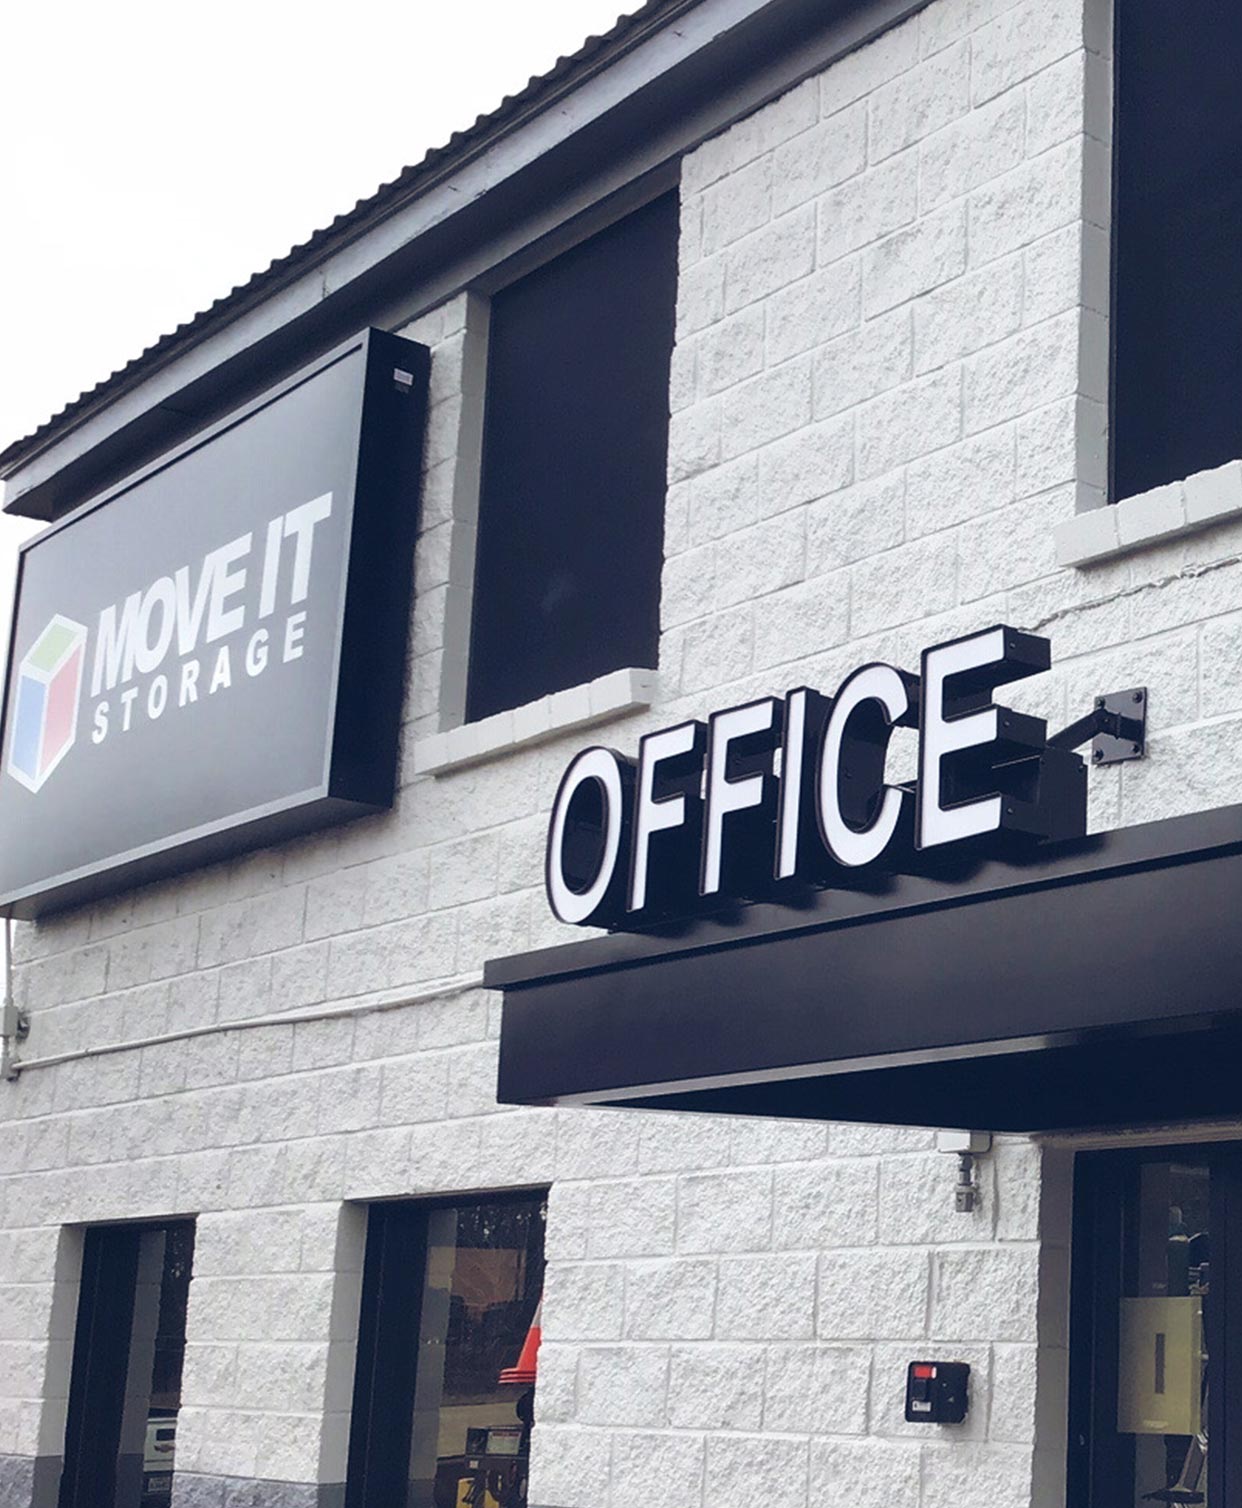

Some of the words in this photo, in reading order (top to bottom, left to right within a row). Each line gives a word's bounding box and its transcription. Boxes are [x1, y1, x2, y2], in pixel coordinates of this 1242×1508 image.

[91, 532, 252, 698] MOVE
[258, 491, 333, 618] IT
[91, 611, 307, 745] STORAGE
[546, 624, 1008, 925] OFFICE
